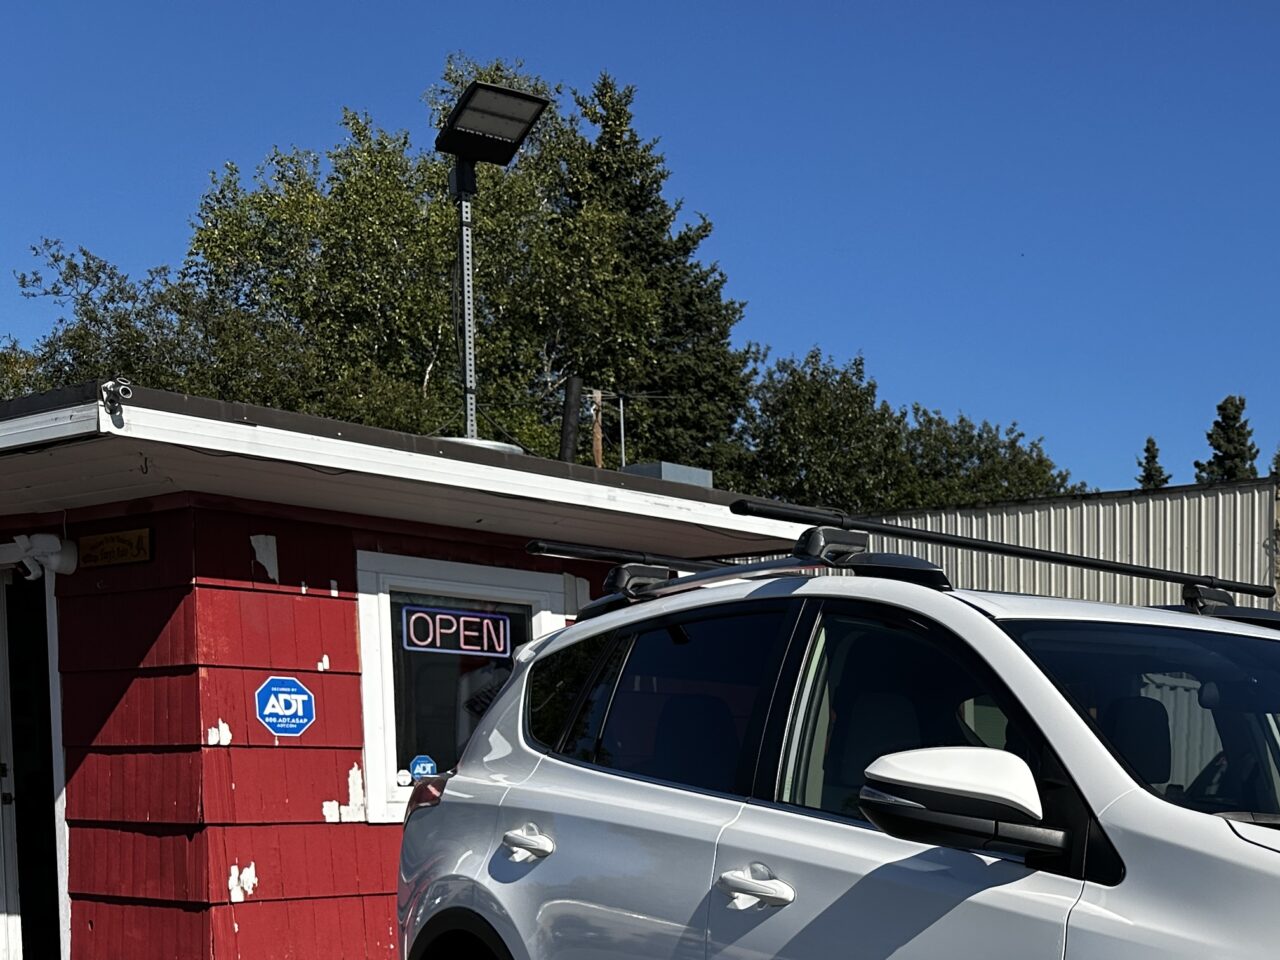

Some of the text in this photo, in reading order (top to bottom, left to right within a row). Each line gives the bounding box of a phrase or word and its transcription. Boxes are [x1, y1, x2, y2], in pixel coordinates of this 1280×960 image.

[408, 612, 504, 652] OPEN
[263, 693, 309, 717] ADT
[413, 763, 434, 775] ADT
